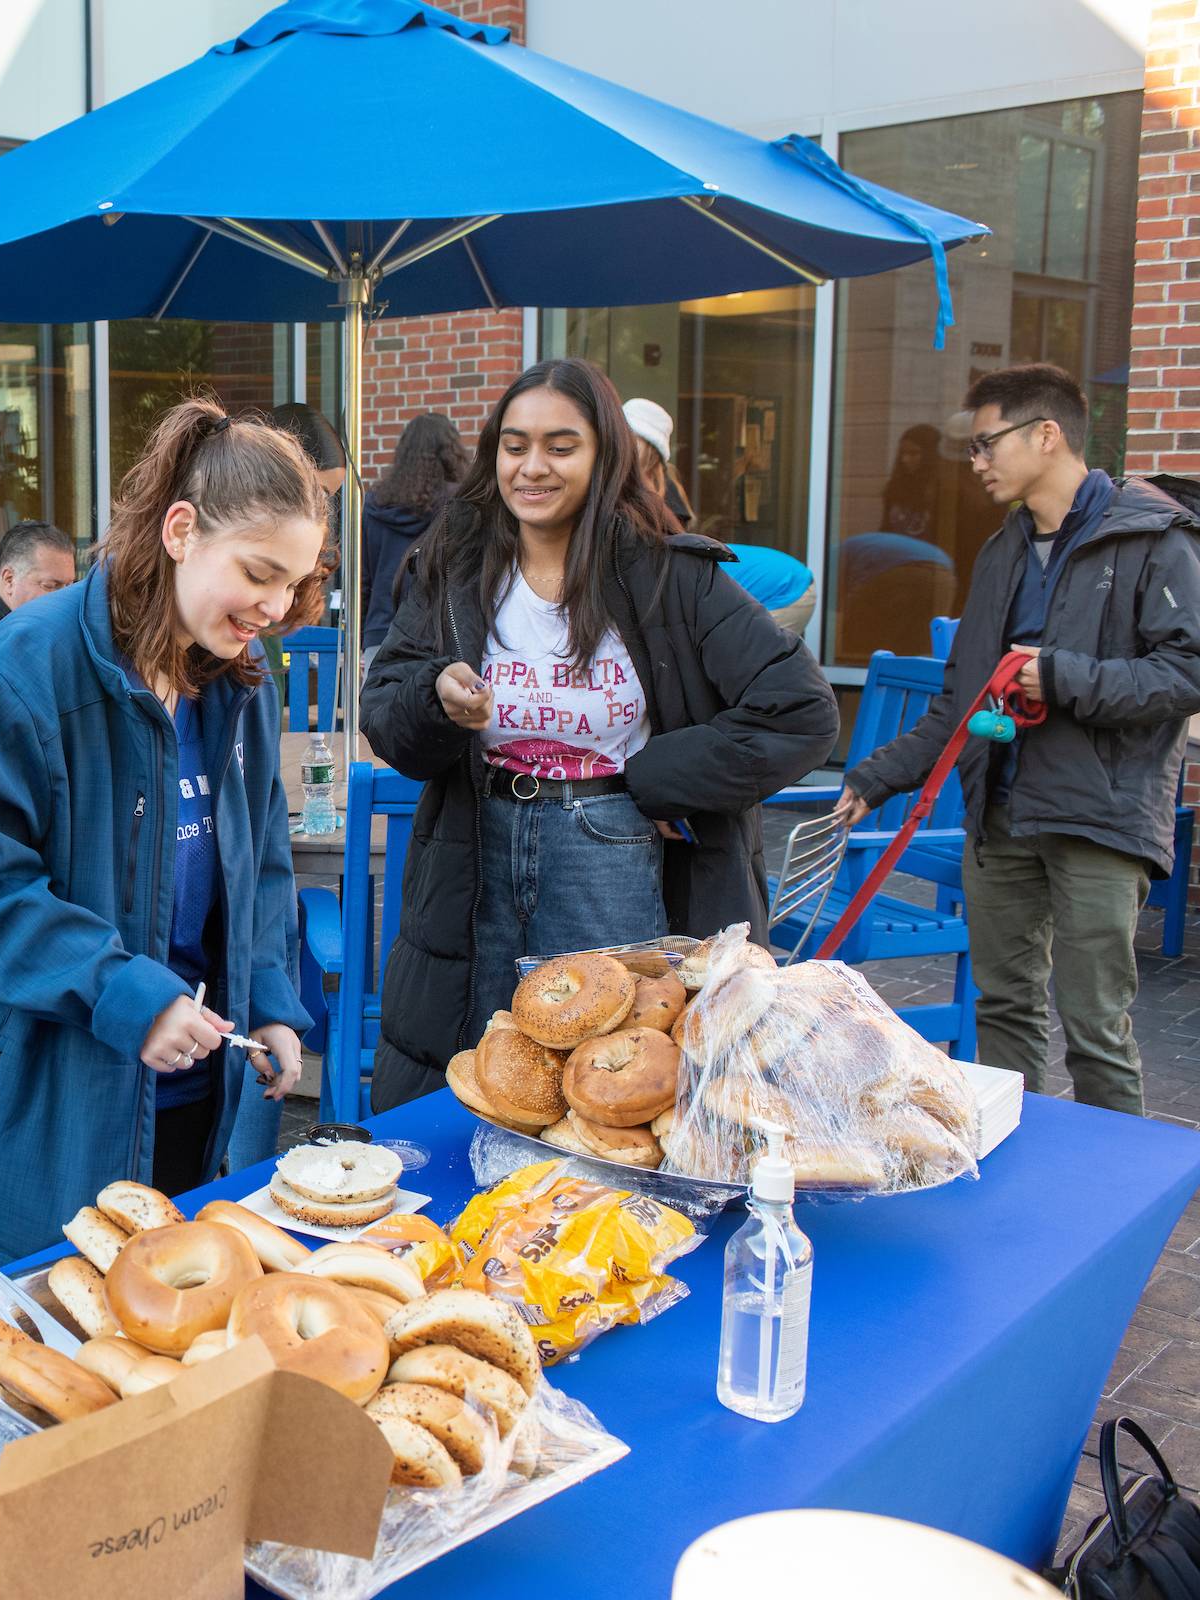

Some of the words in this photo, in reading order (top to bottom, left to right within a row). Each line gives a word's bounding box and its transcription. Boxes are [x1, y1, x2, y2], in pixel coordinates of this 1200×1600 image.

[482, 661, 540, 689] APPA
[552, 658, 627, 691] DELTA
[497, 704, 592, 735] KAPPA
[606, 698, 639, 727] PSI
[88, 1517, 166, 1558] Cheese
